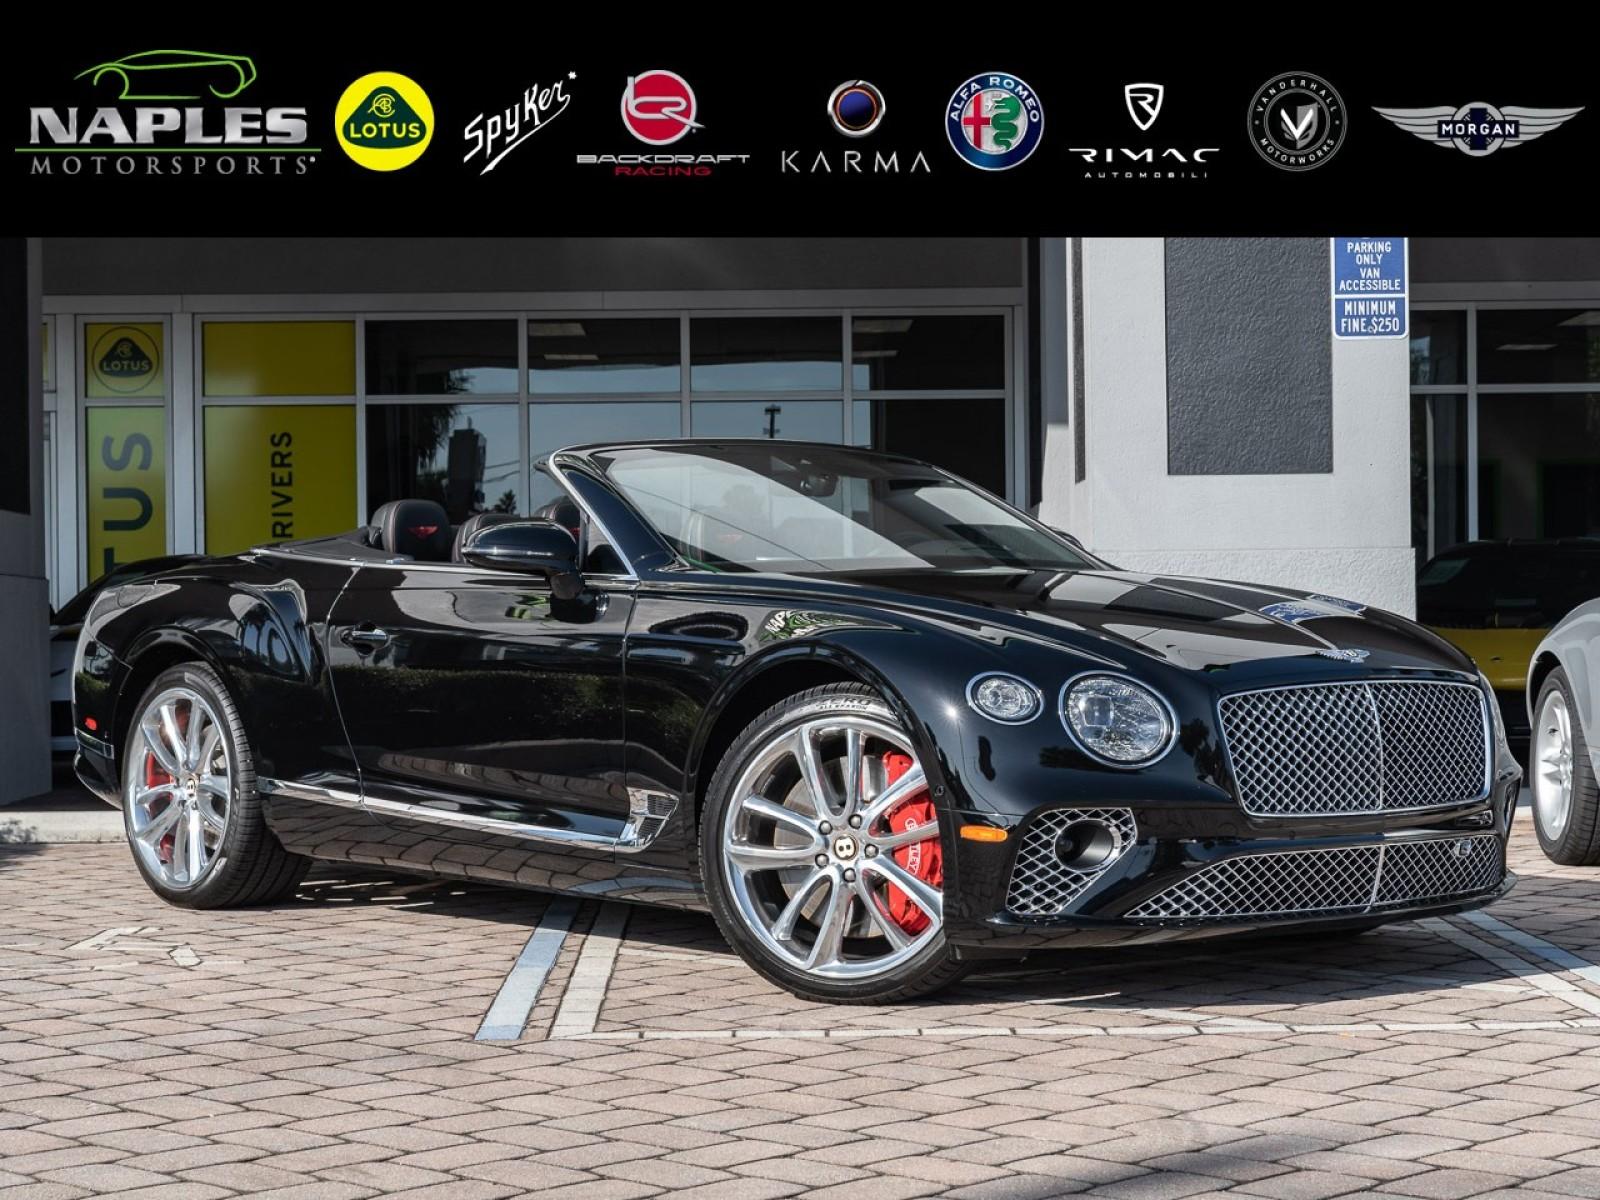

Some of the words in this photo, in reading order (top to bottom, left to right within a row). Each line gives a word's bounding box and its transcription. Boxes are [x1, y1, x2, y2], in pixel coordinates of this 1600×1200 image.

[1346, 242, 1392, 253] PARKING
[1355, 254, 1383, 265] ONLY
[1359, 267, 1380, 279] VAN
[1339, 279, 1401, 291] ACCESSIBLE
[1344, 300, 1396, 316] MINIMUM
[1341, 318, 1367, 333] FINE
[1371, 315, 1400, 334] $250
[103, 359, 149, 372] LOTUS
